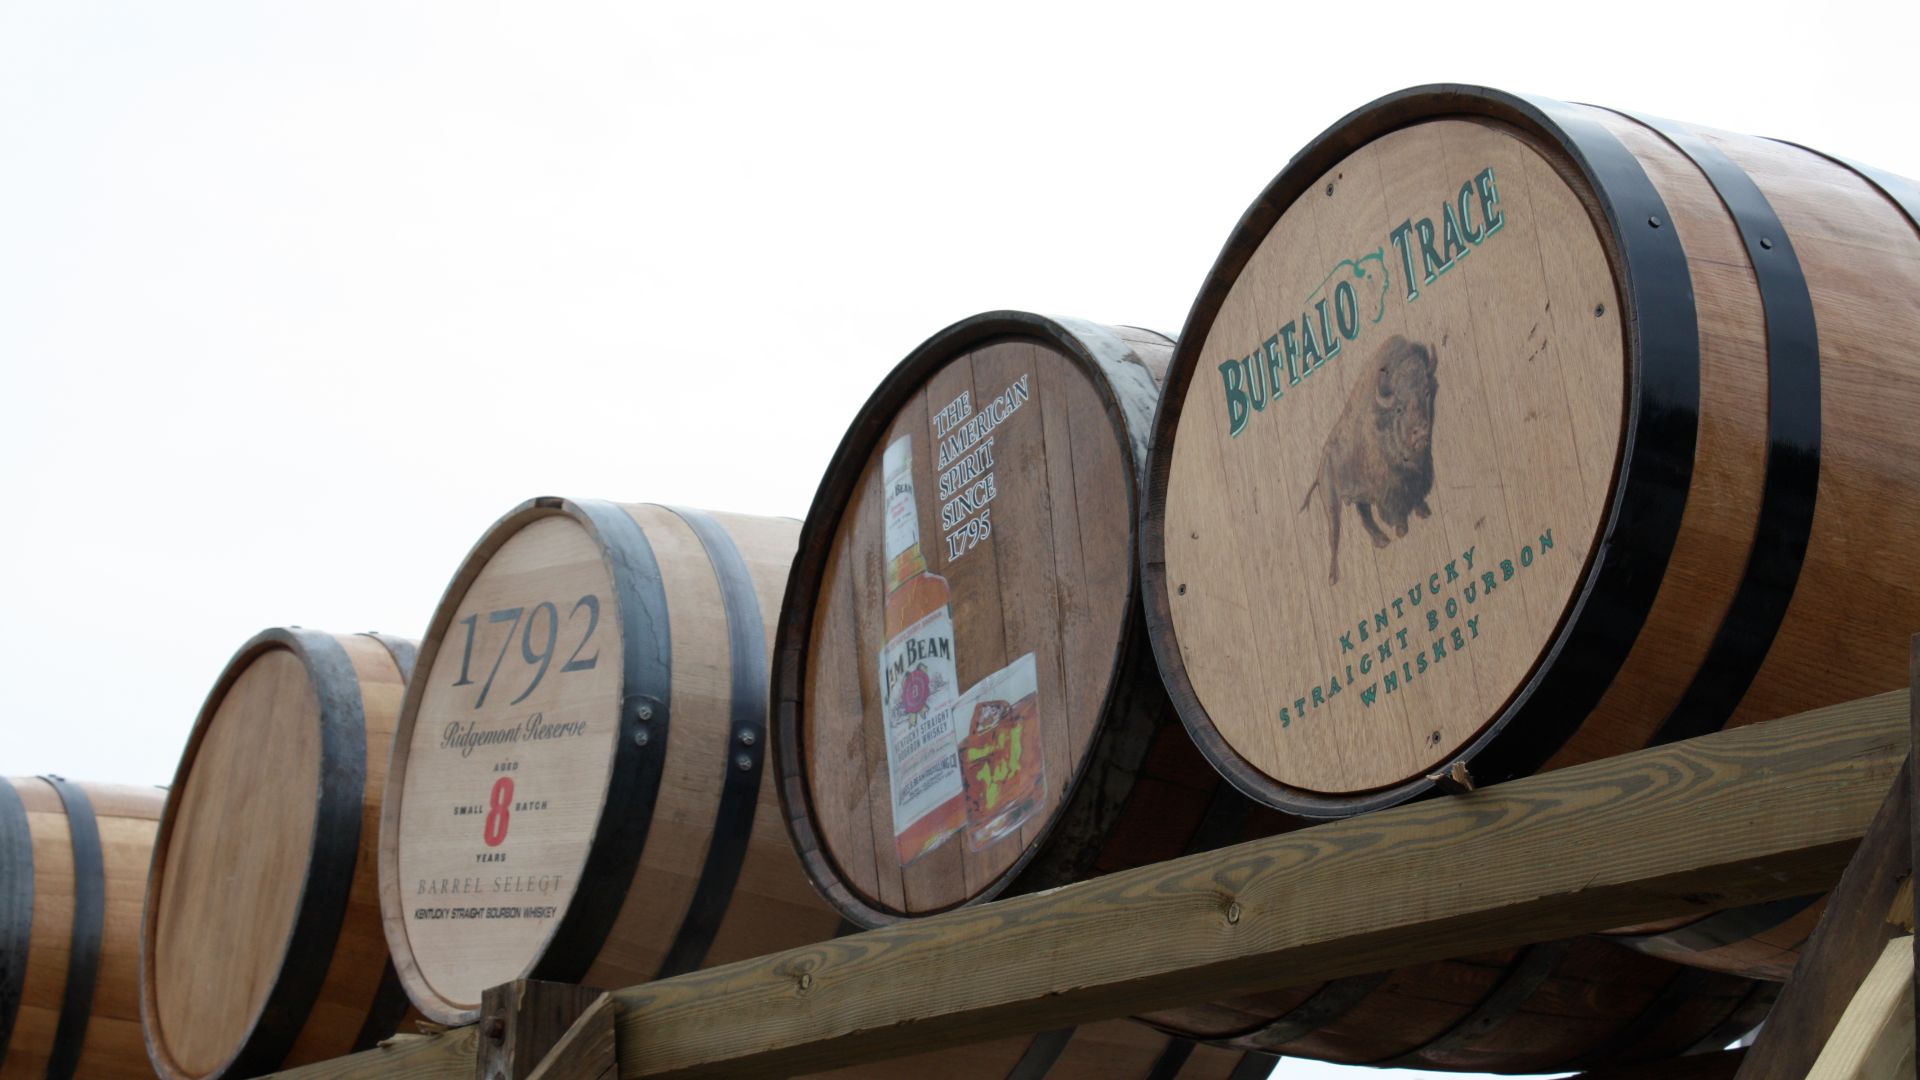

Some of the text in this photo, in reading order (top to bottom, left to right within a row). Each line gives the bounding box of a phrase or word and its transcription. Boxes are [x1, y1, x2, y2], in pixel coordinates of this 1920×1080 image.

[1218, 166, 1505, 439] BUFFALO TRACE
[933, 390, 972, 439] THE
[937, 373, 1030, 471] AMERICAN
[939, 435, 994, 501] SPIRIT
[942, 472, 997, 531] SINCE
[946, 508, 992, 562] 1795
[1279, 528, 1554, 728] STRAIGHT BOURBON
[1339, 546, 1475, 654] KENTUCKY
[452, 594, 600, 710] 1792
[884, 637, 950, 706] JIM BEAM
[1360, 615, 1480, 708] WHISKEY
[440, 712, 587, 758] Ridgemont Reserve
[920, 708, 949, 734] STRAIGHT
[921, 721, 948, 745] WHISKEY
[493, 762, 519, 772] AGED
[454, 801, 547, 816] SMALL BATCH
[484, 776, 515, 848] 8
[417, 877, 482, 895] BARREL
[476, 853, 506, 863] YEARS
[414, 906, 557, 920] KENTUCKY STRAIGHT BOURBON WHISKEY
